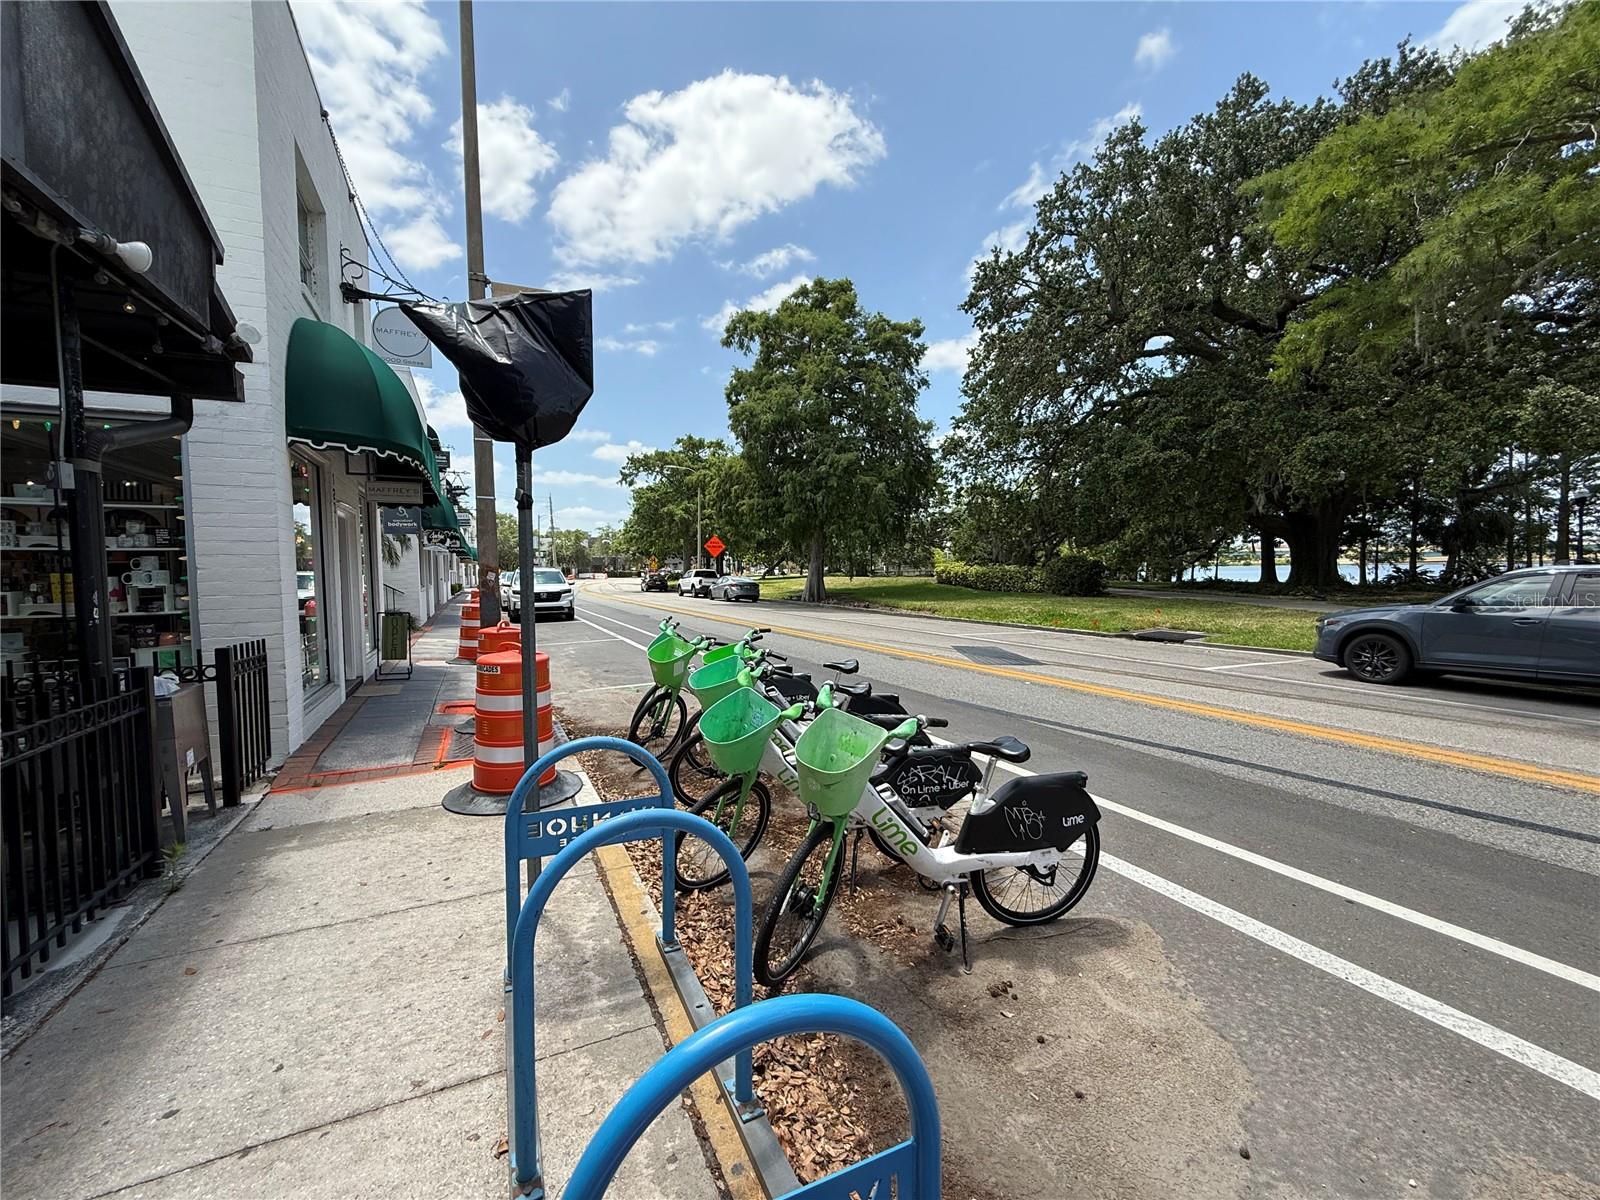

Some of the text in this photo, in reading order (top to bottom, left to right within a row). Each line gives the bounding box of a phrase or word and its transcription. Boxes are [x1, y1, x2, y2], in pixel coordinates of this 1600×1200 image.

[901, 784, 916, 795] On
[917, 784, 941, 794] Lime
[948, 780, 969, 790] Uber
[1062, 814, 1085, 827] Lime
[871, 806, 918, 856] Lime
